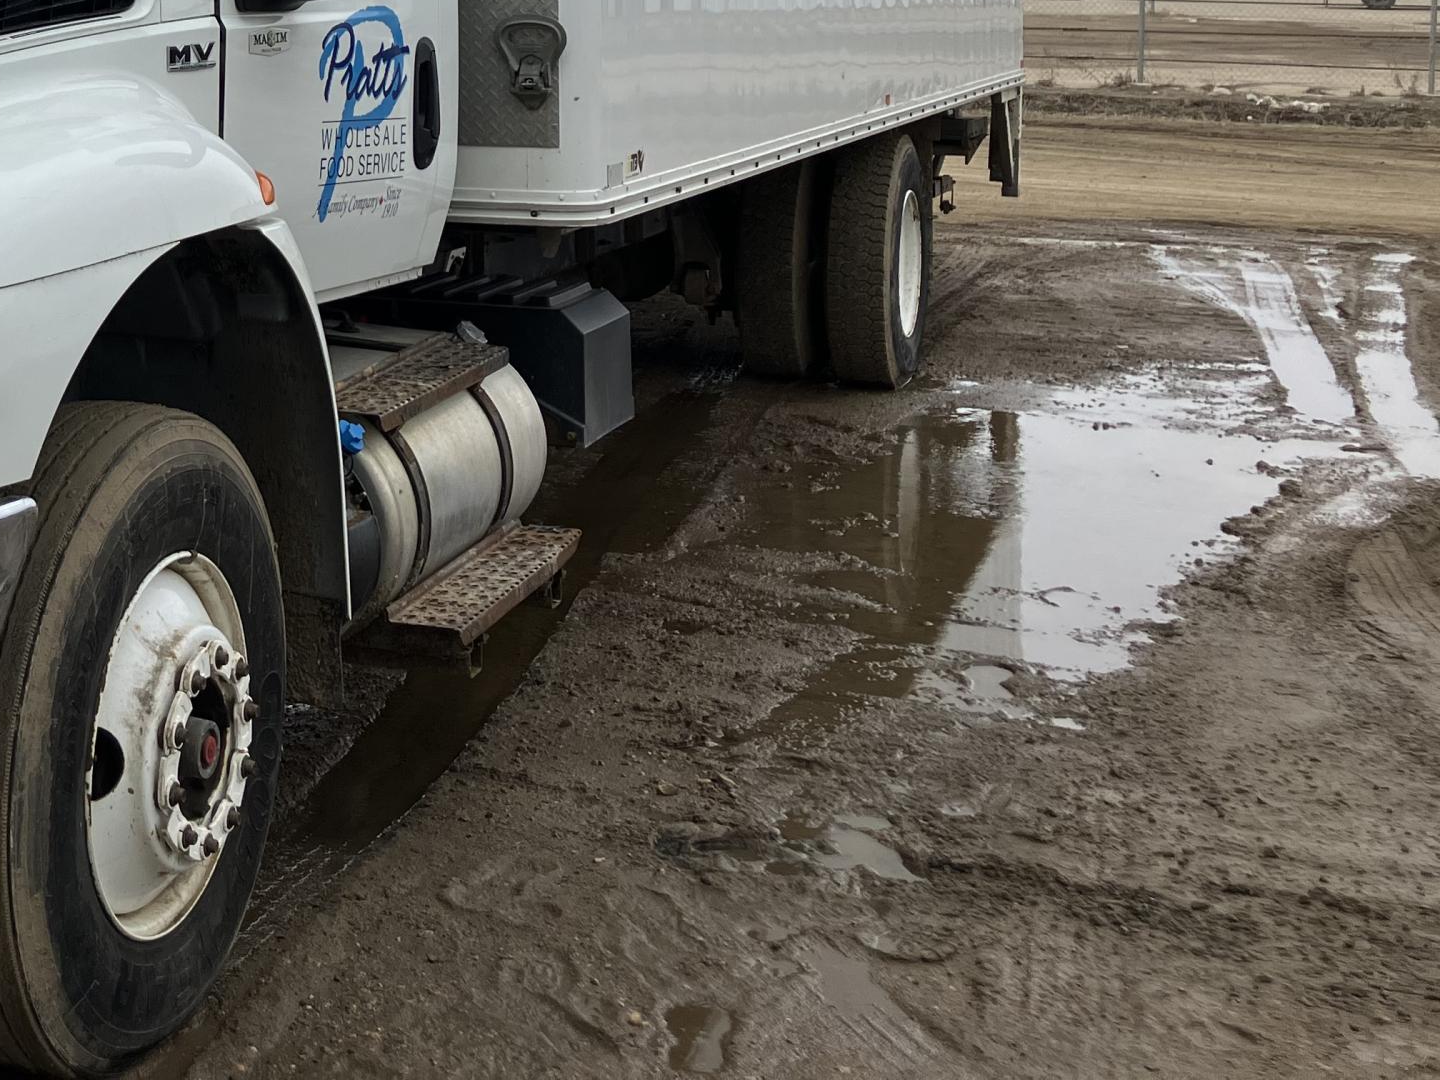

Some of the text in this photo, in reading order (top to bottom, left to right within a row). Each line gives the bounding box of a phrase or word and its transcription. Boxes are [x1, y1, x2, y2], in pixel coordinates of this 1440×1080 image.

[167, 42, 215, 64] MV
[322, 22, 409, 103] Pratts
[321, 124, 406, 151] WHOLESALE
[319, 151, 405, 179] FOOD SERVICE
